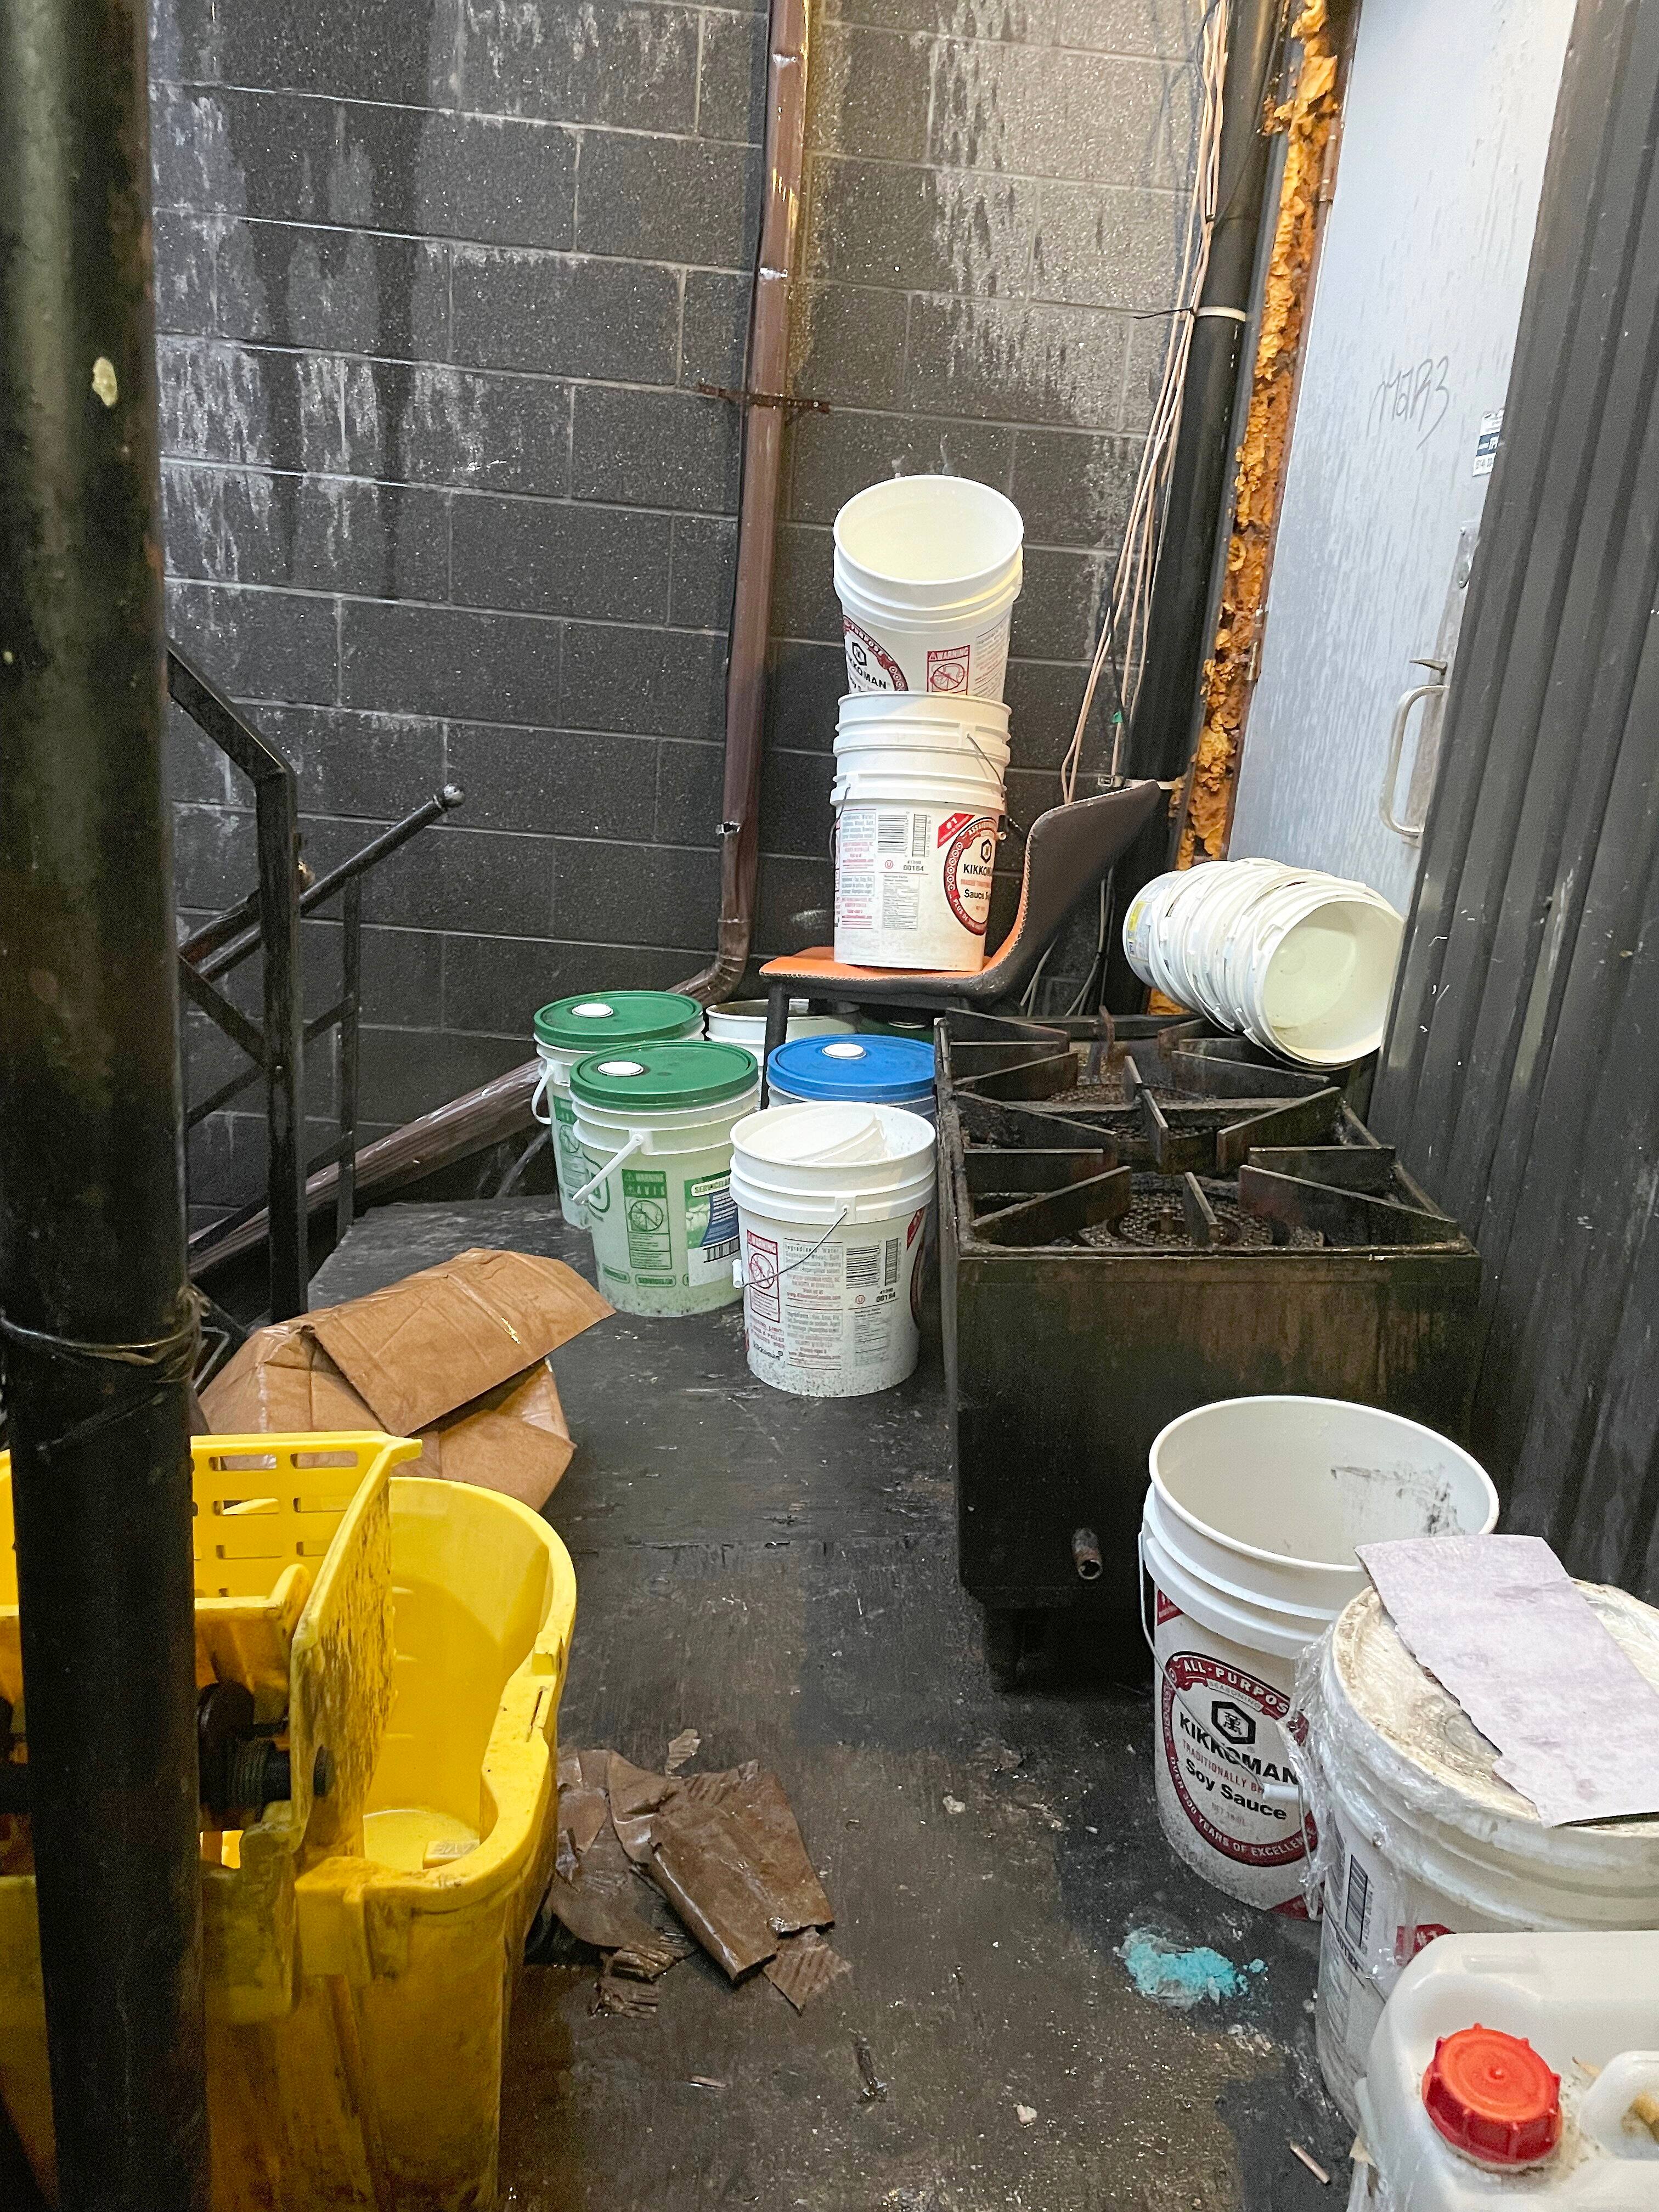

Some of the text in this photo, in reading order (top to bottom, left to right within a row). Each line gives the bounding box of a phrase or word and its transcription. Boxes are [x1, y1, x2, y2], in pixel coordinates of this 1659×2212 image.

[636, 1185, 665, 1195] AVIS
[1183, 1660, 1290, 1714] ALL-PURPOS
[1209, 1680, 1262, 1710] SEASONING
[1180, 1712, 1299, 1785] KIKKOMAN
[1183, 1739, 1248, 1788] TRADITIONALLY
[1170, 1756, 1184, 1790] OVER
[1182, 1793, 1198, 1815] 300
[1199, 1815, 1229, 1847] YEARS
[1232, 1842, 1248, 1853] OF
[1186, 1758, 1288, 1821] Soy Sauce
